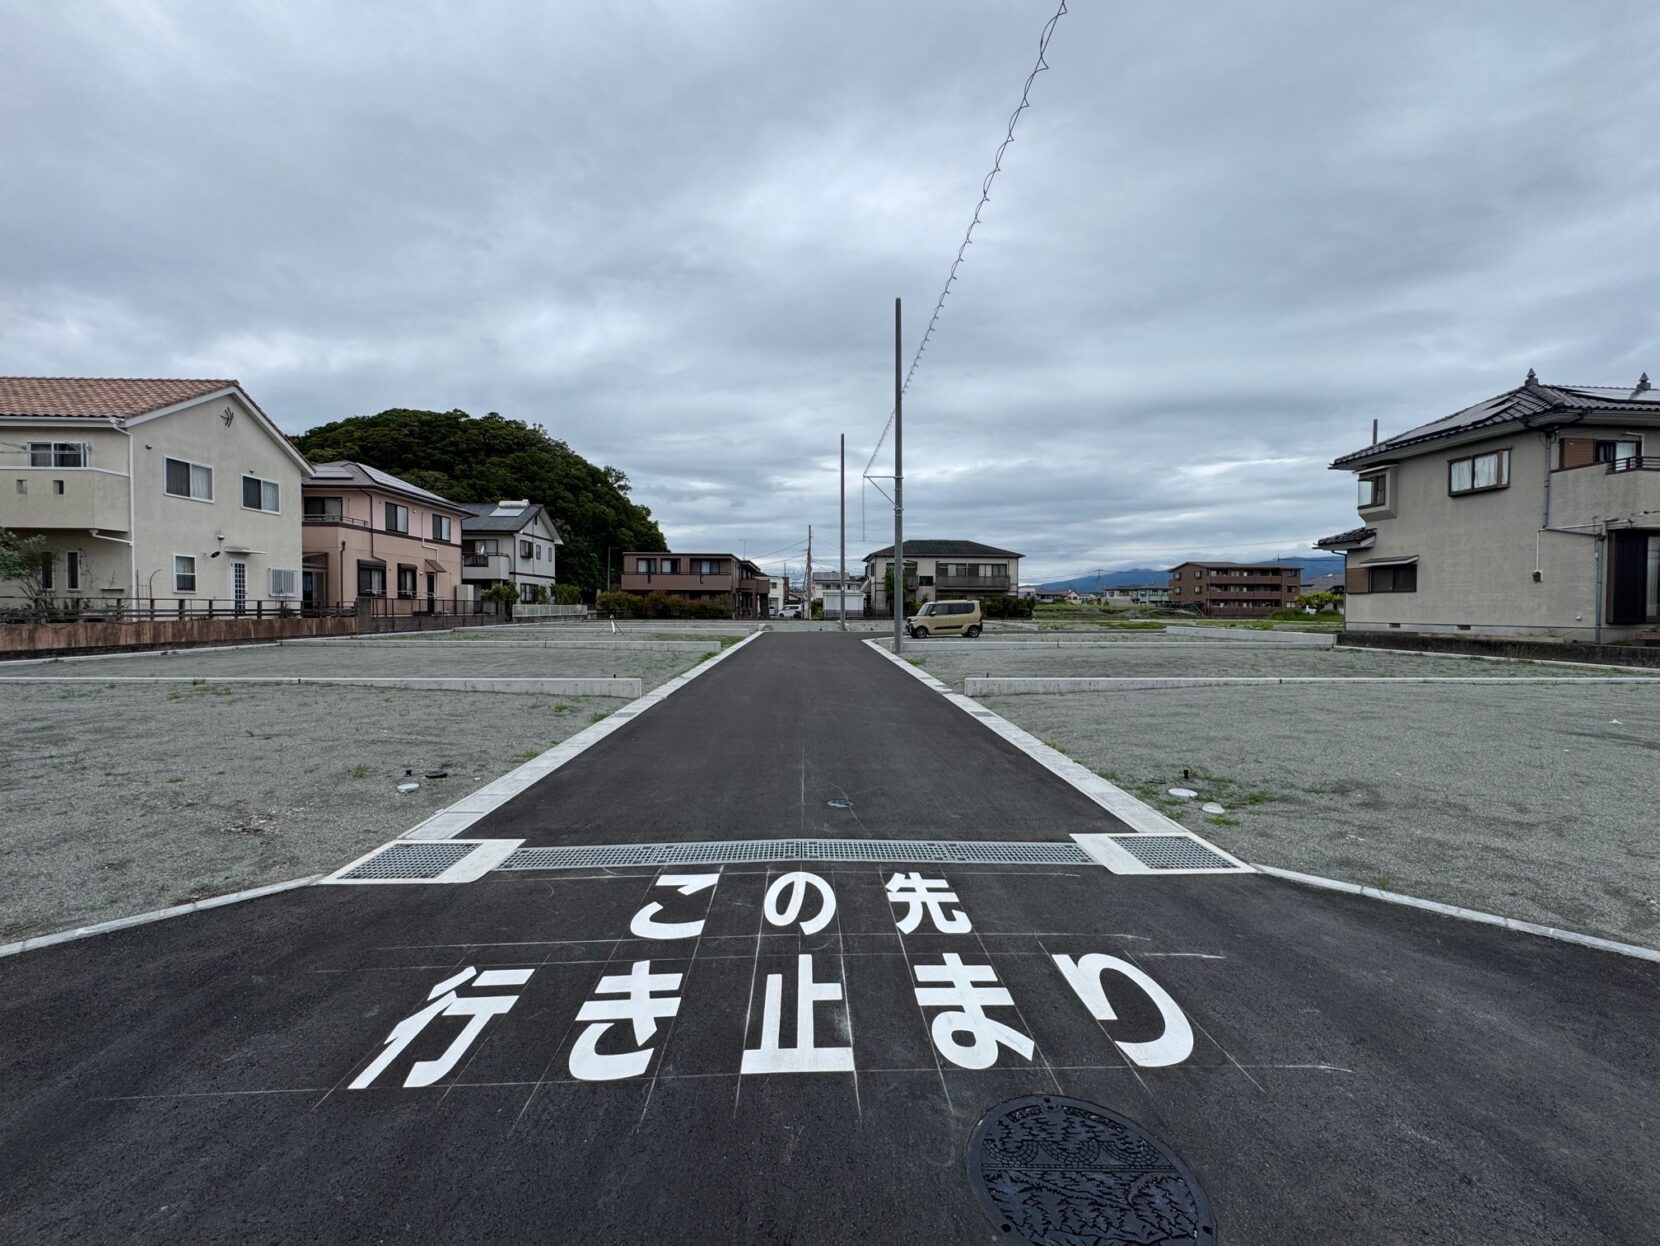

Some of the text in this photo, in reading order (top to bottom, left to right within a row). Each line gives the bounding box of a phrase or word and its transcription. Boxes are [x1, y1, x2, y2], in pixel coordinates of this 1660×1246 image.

[630, 872, 972, 940] この先
[348, 953, 1195, 1089] 行き止まり
